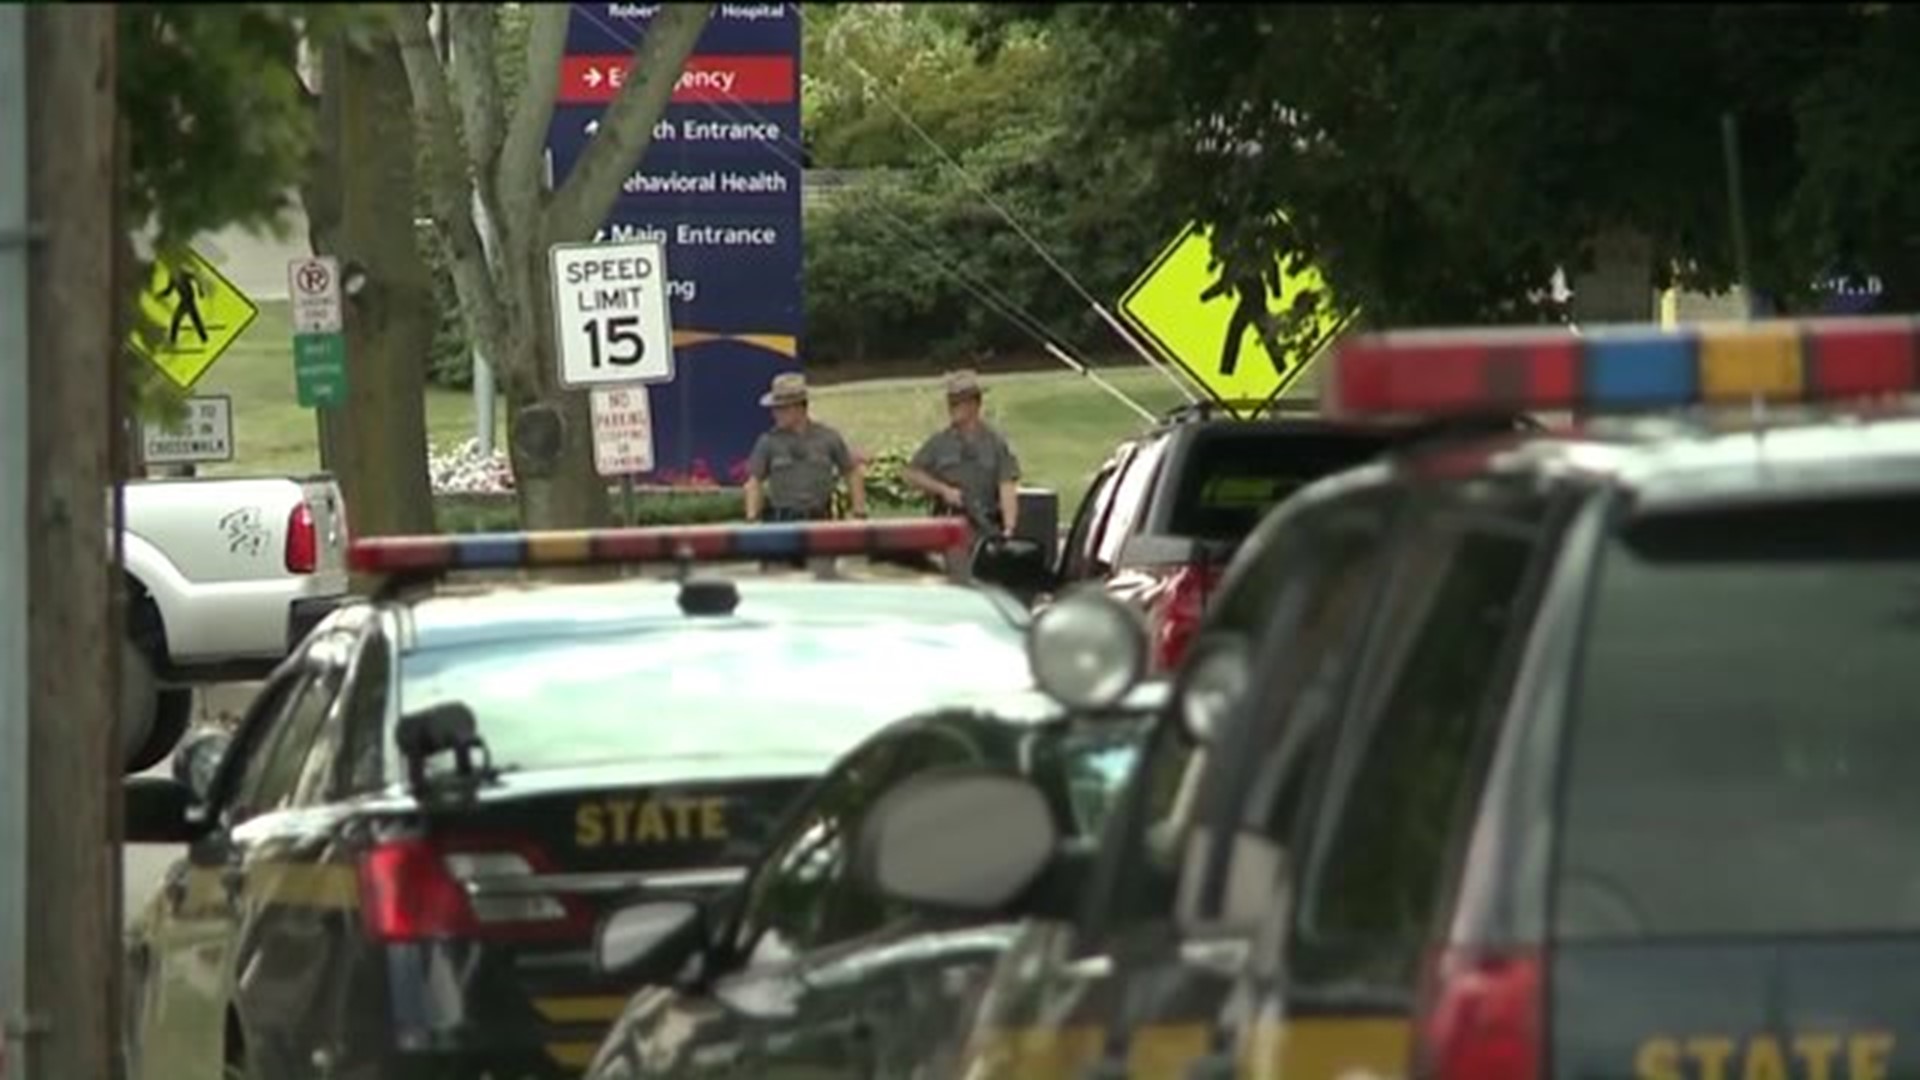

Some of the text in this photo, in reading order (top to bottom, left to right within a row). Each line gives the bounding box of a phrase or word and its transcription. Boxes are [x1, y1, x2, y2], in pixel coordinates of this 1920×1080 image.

[722, 3, 784, 20] Hospital
[608, 67, 735, 92] Eency
[684, 121, 779, 140] Entrance
[624, 172, 787, 192] ehavioral Health
[611, 224, 776, 244] Main Entrance
[566, 258, 652, 284] SPEED
[578, 288, 643, 312] LIMIT
[583, 317, 645, 368] 15
[608, 392, 629, 408] NO
[596, 410, 647, 428] PARKING
[149, 438, 225, 457] CROSSWALK
[576, 797, 728, 846] STATE
